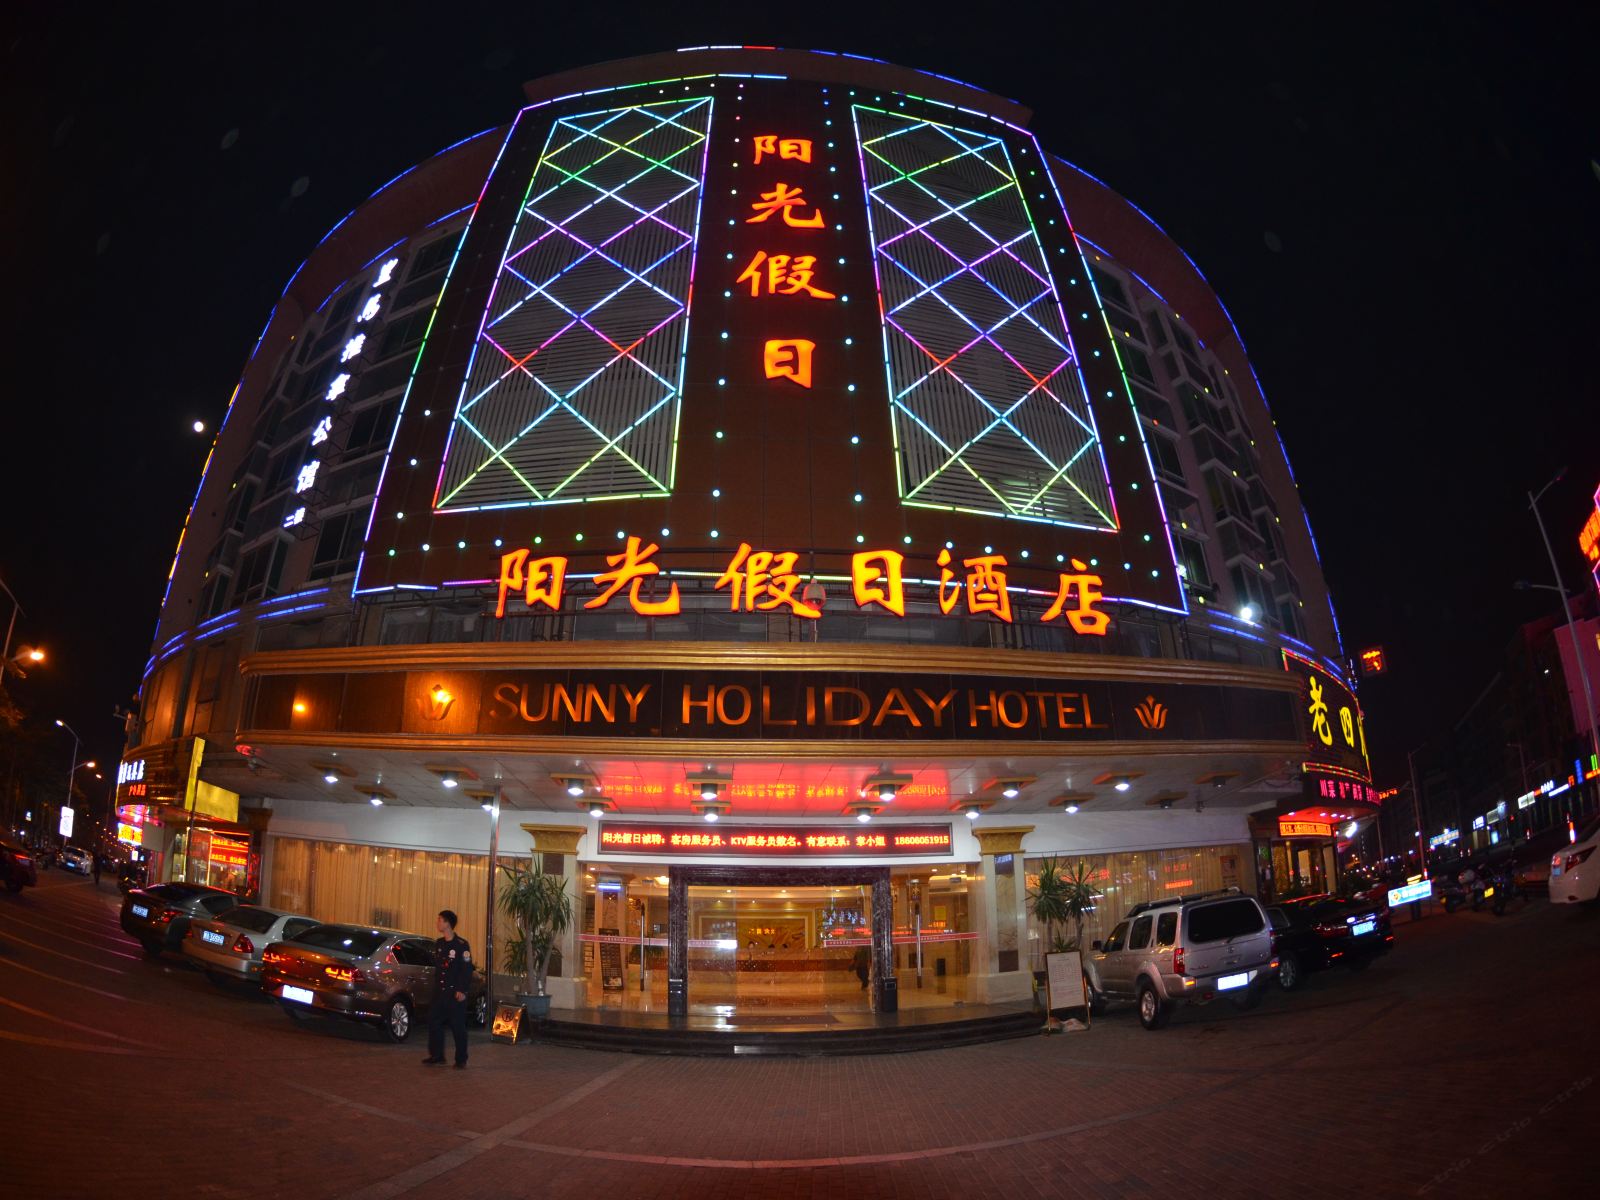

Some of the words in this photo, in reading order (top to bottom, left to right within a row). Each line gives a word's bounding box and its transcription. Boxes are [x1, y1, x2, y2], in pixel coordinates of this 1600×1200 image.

[736, 135, 836, 389] 阳光假日
[495, 536, 1111, 636] 阳光假日酒店
[490, 682, 651, 725] SUNNY
[681, 684, 957, 728] HOLIDAY
[968, 690, 1110, 731] HOTEL
